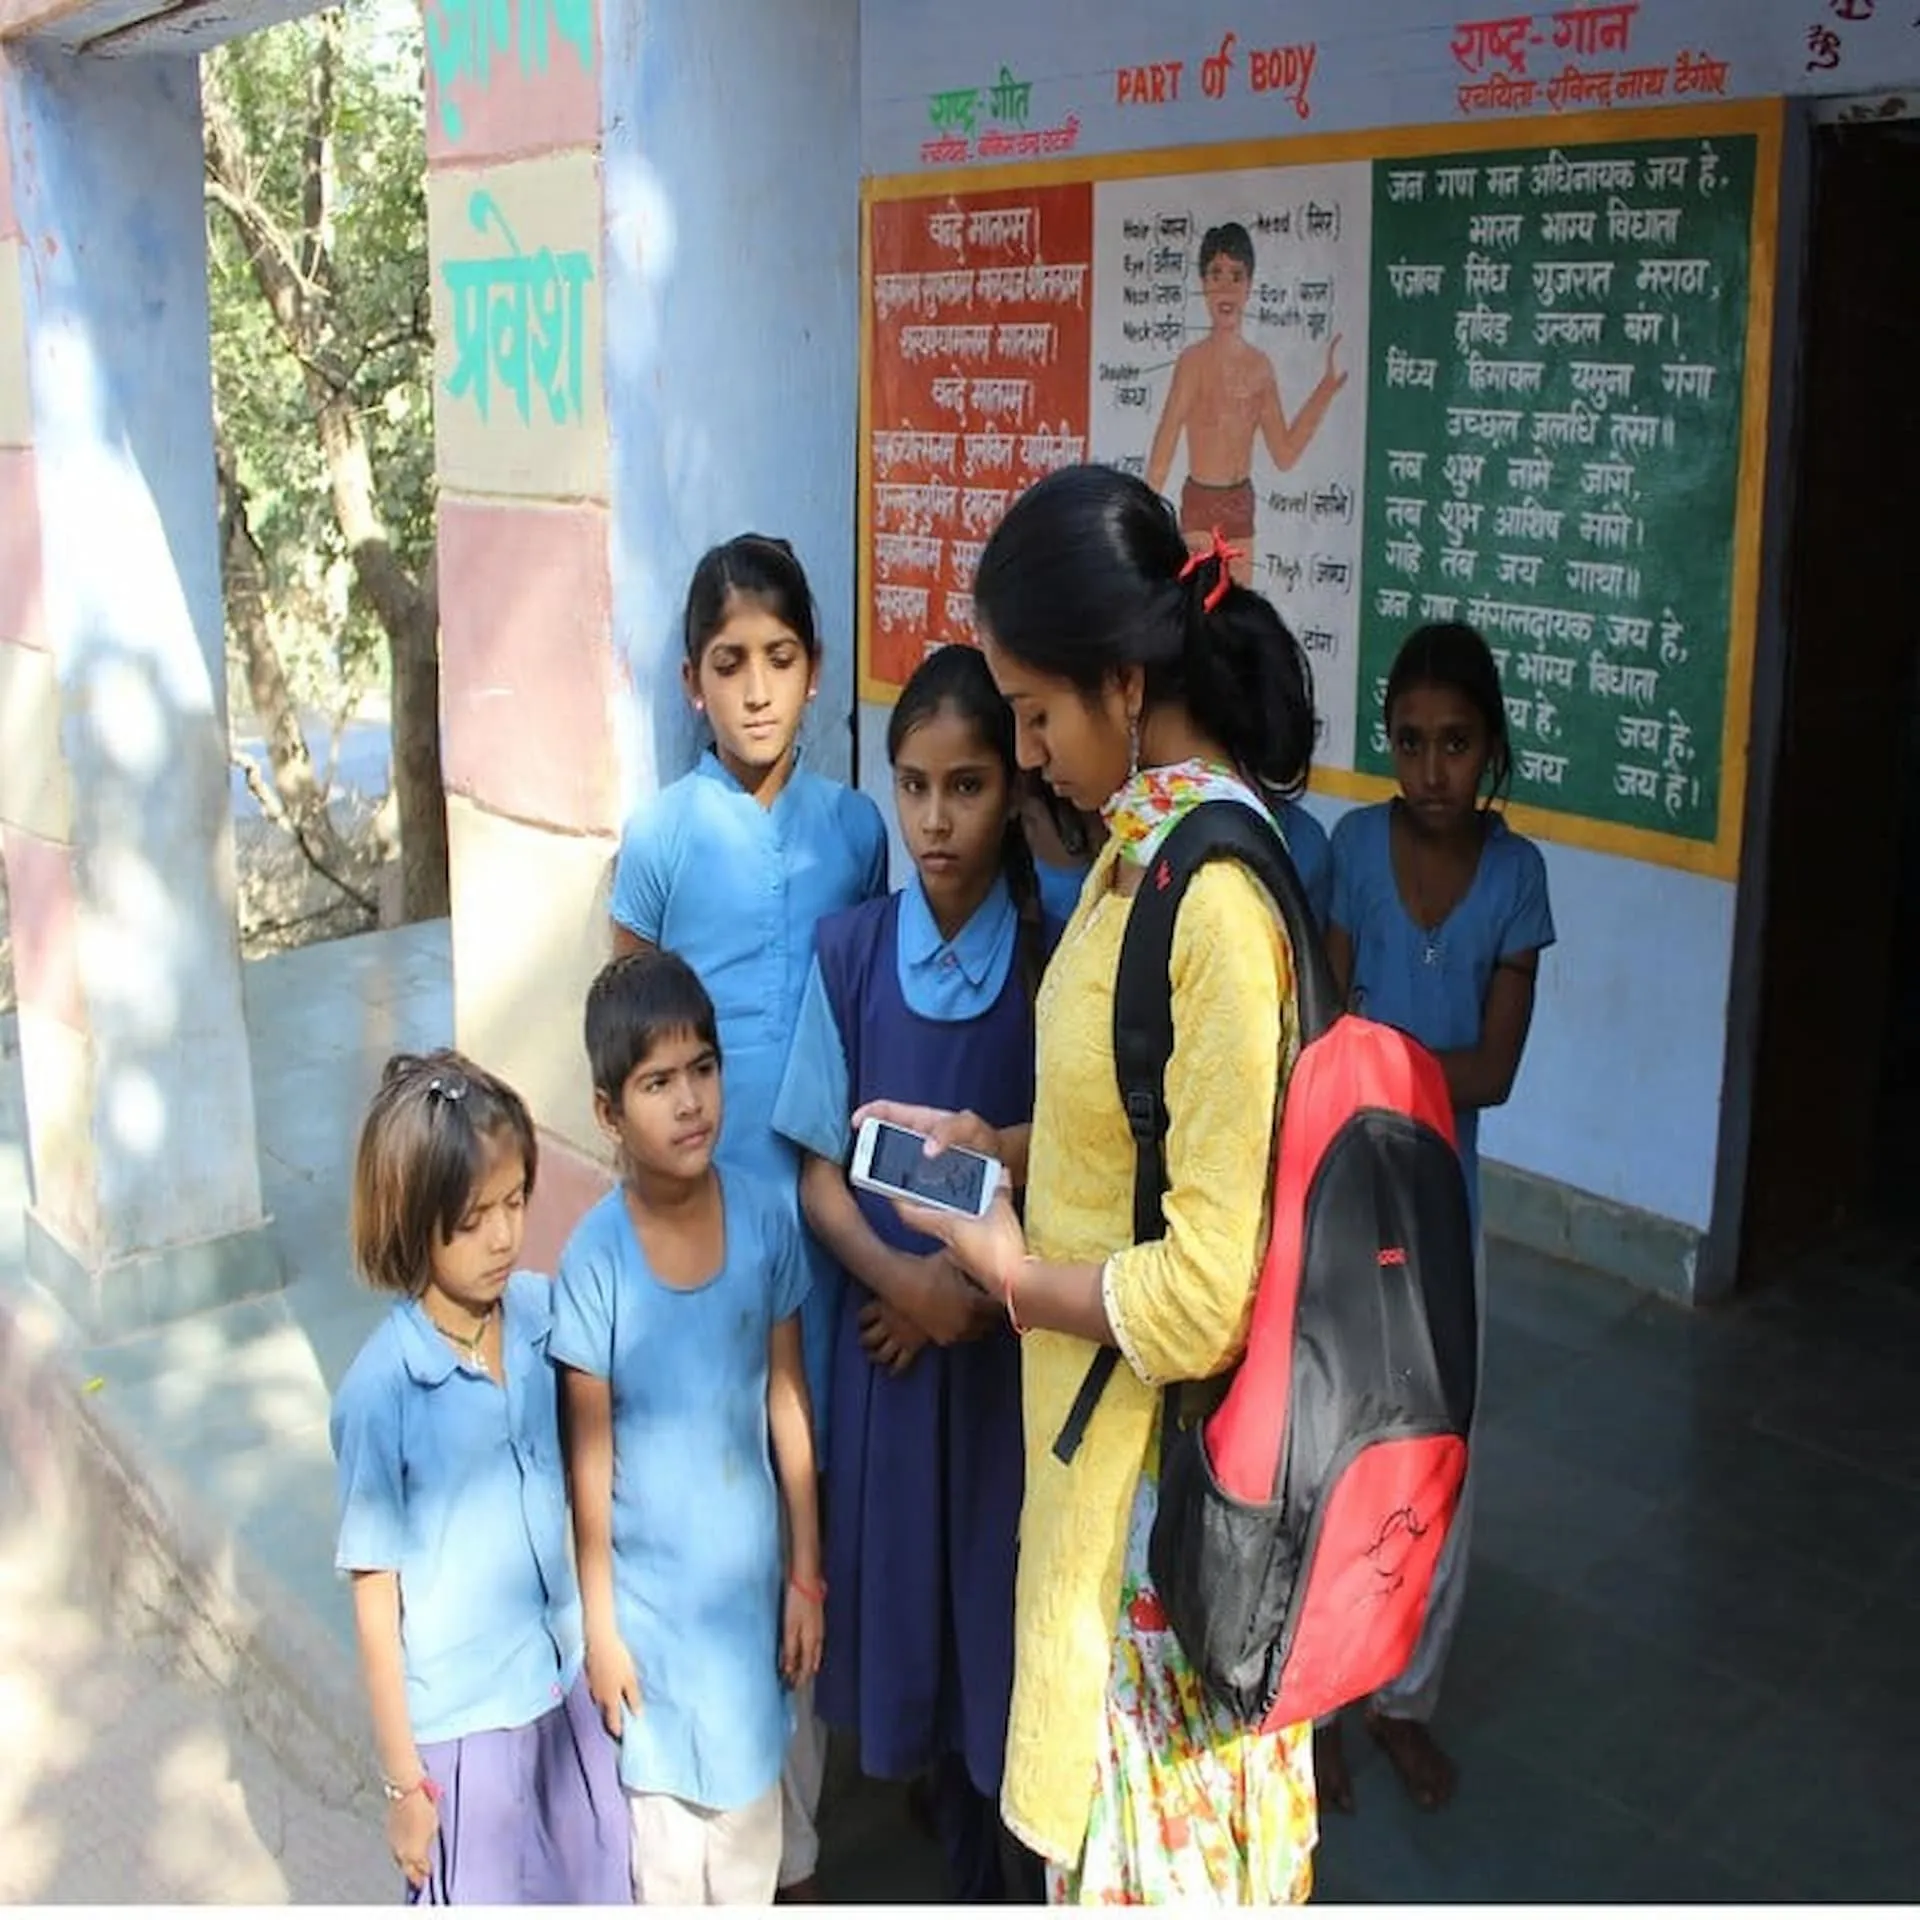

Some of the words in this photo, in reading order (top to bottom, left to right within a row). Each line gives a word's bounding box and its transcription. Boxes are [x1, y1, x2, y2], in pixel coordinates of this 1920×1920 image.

[1116, 62, 1184, 104] PART
[1250, 42, 1317, 119] BODY
[1388, 170, 1426, 202] जन
[1436, 167, 1478, 199] गण
[1487, 165, 1523, 198] मन
[1645, 157, 1688, 192] जय
[1469, 214, 1524, 251] भारत
[1541, 210, 1597, 246] भाग्य
[1608, 196, 1682, 246] विधाता
[1533, 261, 1615, 306] गुजरात
[441, 189, 594, 429] प्रवेश
[1465, 350, 1546, 393] हिमाचल
[1569, 360, 1635, 410] यमुना
[1661, 353, 1717, 399] गंगा
[1531, 400, 1600, 447] जलधि
[1442, 453, 1486, 500] शुभ
[1437, 499, 1484, 546] शुभ
[1497, 554, 1544, 587] जय
[1606, 614, 1654, 652] जय
[1516, 650, 1577, 692] भाग्य
[1588, 649, 1660, 711] विधाता
[1503, 697, 1530, 732] य
[1615, 714, 1664, 753] जय
[1518, 750, 1569, 785] जय
[1612, 763, 1660, 800] जय
